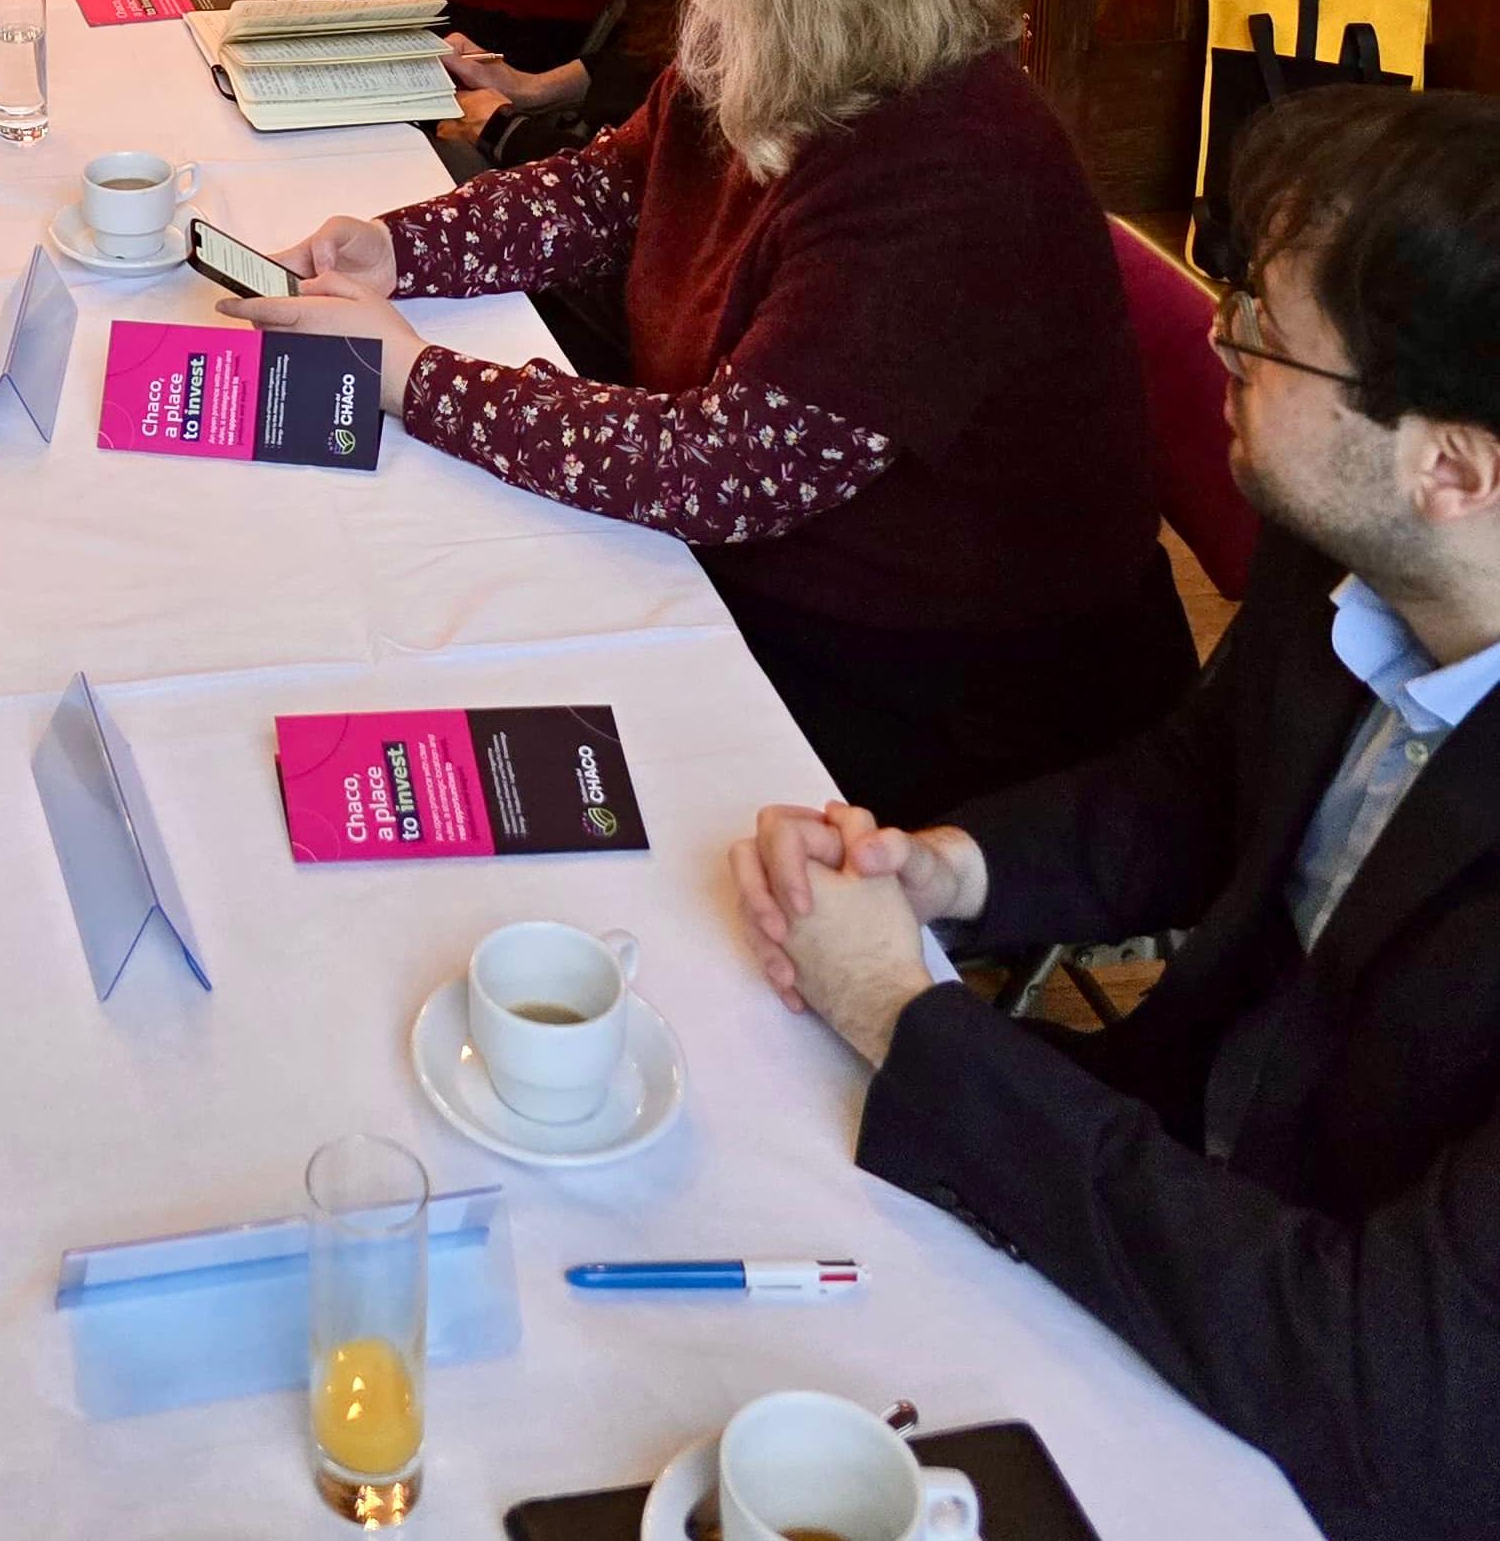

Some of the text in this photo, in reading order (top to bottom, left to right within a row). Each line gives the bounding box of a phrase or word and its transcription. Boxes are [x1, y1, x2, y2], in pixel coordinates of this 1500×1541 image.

[141, 377, 166, 437] Chaco,
[163, 372, 184, 439] a place
[340, 373, 356, 427] CHACO
[183, 420, 199, 440] to
[368, 765, 396, 841] a place
[578, 745, 604, 804] CHACO
[344, 772, 367, 842] Chaco,
[402, 816, 421, 841] to
